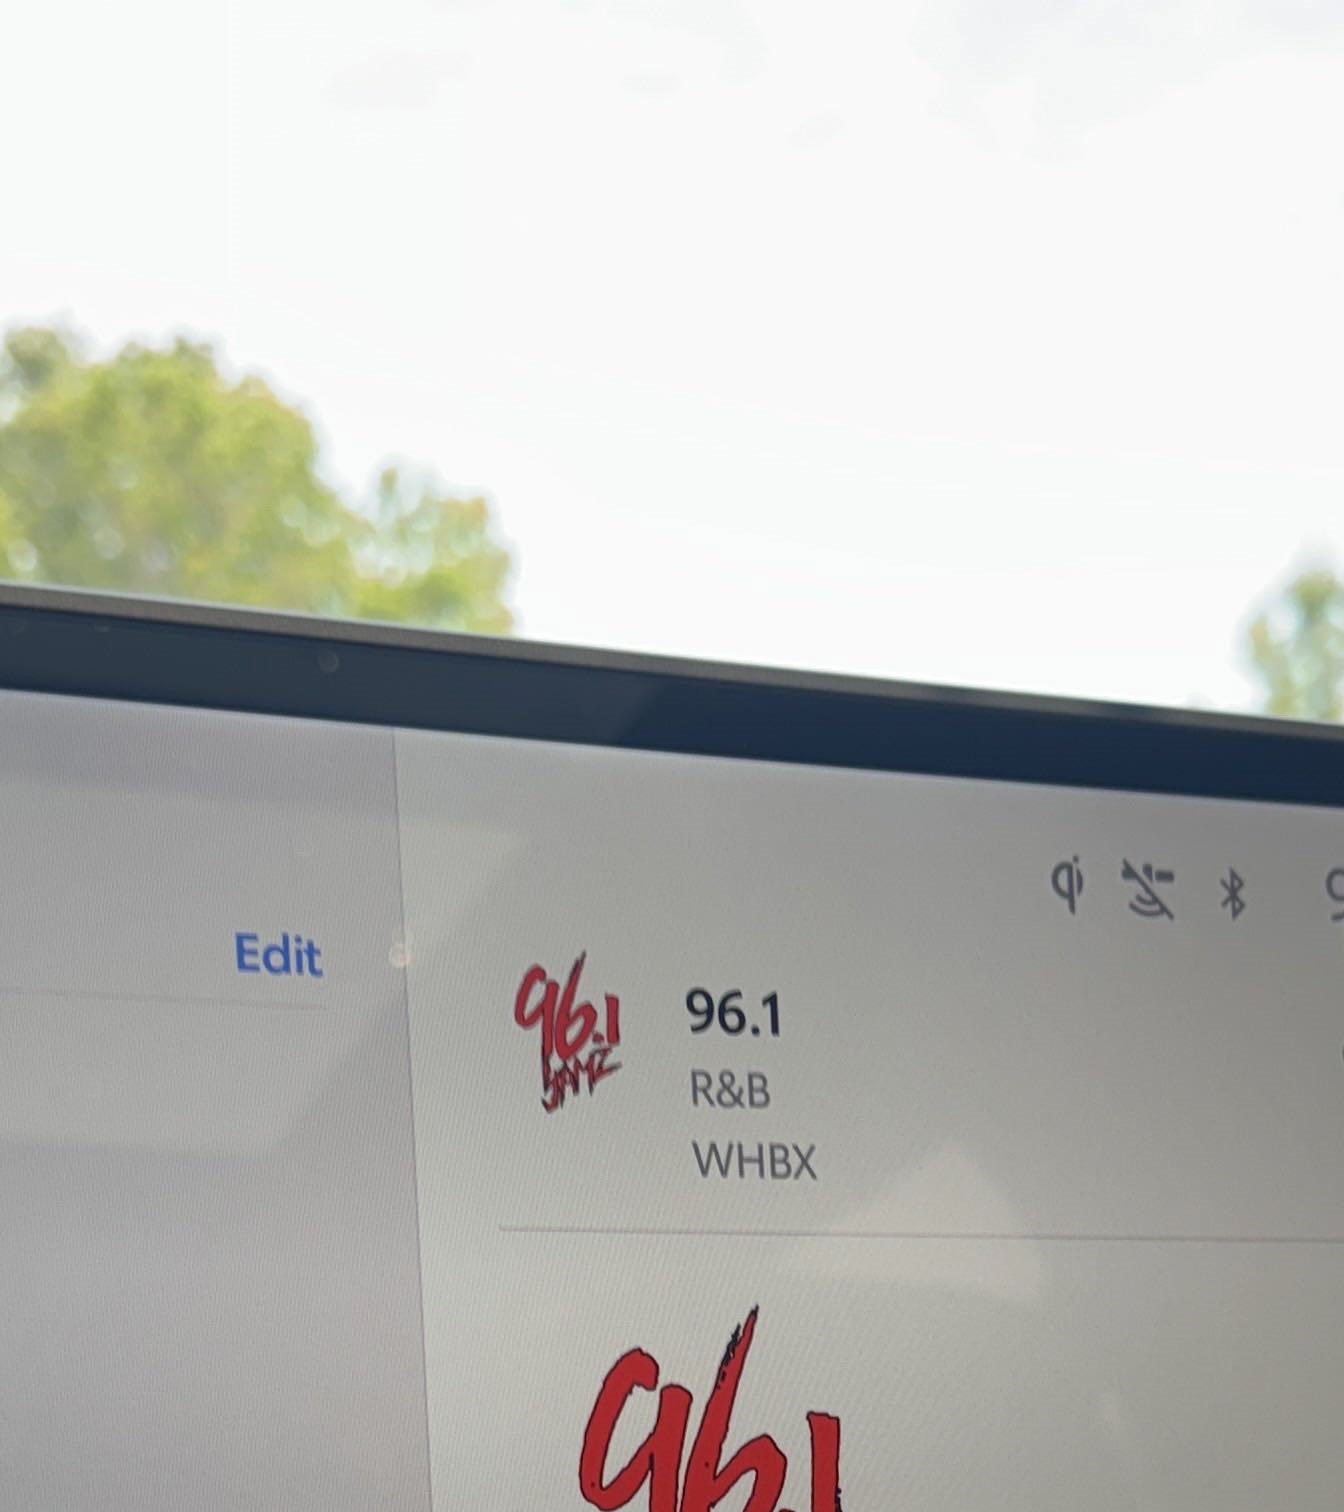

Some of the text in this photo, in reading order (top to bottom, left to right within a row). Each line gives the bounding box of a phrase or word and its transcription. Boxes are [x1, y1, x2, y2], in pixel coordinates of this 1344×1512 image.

[234, 932, 324, 978] Edit
[515, 951, 620, 1095] 96.1
[686, 987, 780, 1038] 96.1
[542, 1048, 621, 1113] JAMZ
[691, 1069, 770, 1109] R&B
[692, 1140, 817, 1181] WHBX
